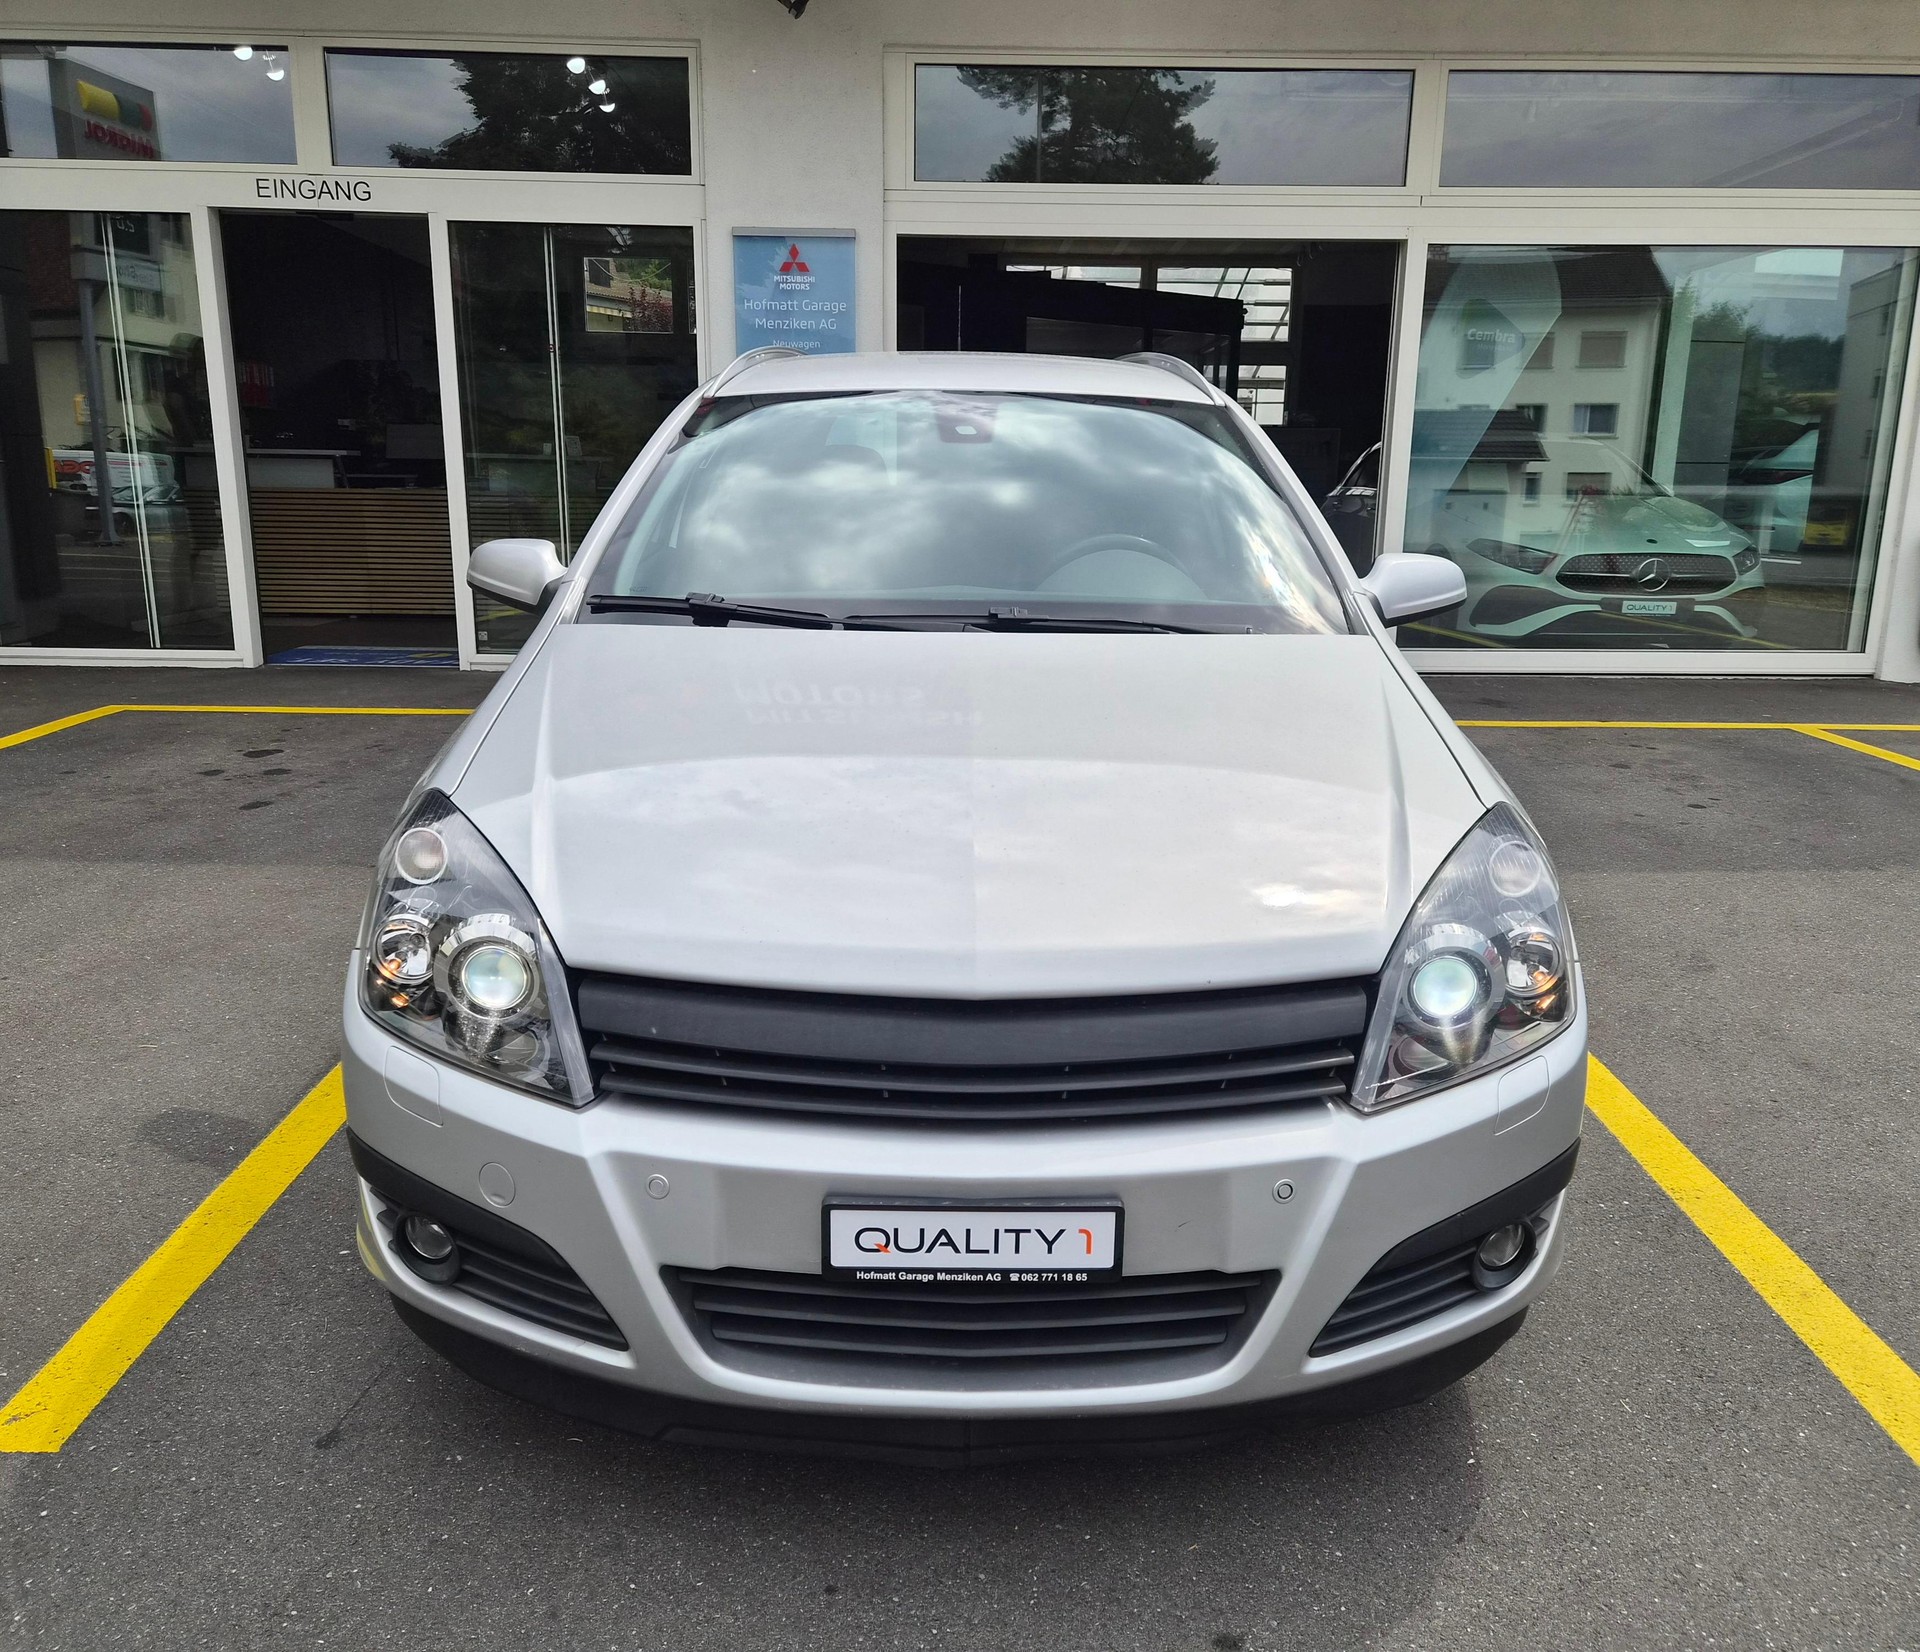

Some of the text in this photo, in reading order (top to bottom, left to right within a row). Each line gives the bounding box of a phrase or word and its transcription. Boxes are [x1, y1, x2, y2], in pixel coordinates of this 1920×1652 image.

[255, 178, 372, 202] EINGANG
[773, 275, 816, 283] MITSUBISHI
[744, 299, 847, 314] Hofmatt Garage
[755, 318, 837, 330] Menziken AG
[1467, 328, 1516, 343] Cembra
[773, 340, 821, 349] Neuwagen
[854, 1227, 1093, 1255] QUALITY 1
[856, 1271, 1088, 1282] Hofmatt Garage Menziken AG 062 771 18 65
